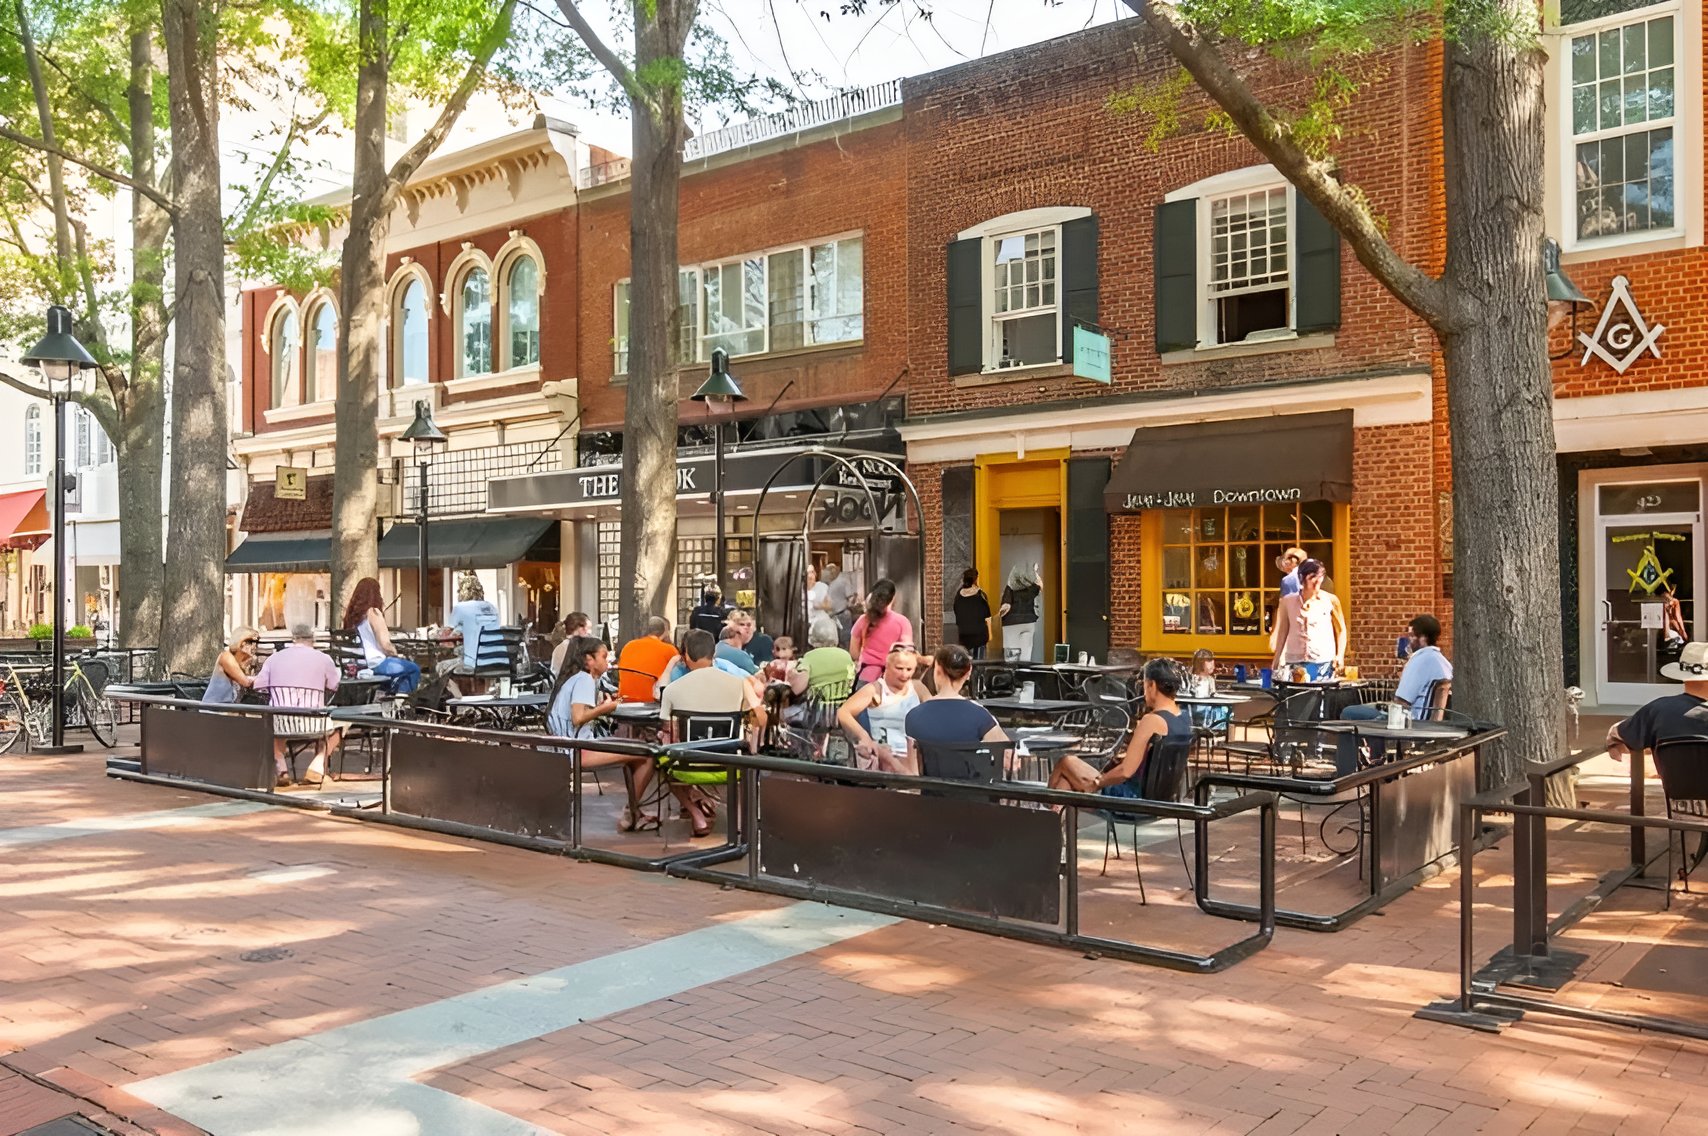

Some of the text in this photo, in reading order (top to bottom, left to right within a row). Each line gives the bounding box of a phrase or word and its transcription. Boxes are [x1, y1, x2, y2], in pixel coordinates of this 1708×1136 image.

[1607, 323, 1634, 350] G
[579, 474, 619, 498] THE
[1213, 488, 1301, 504] Downtown
